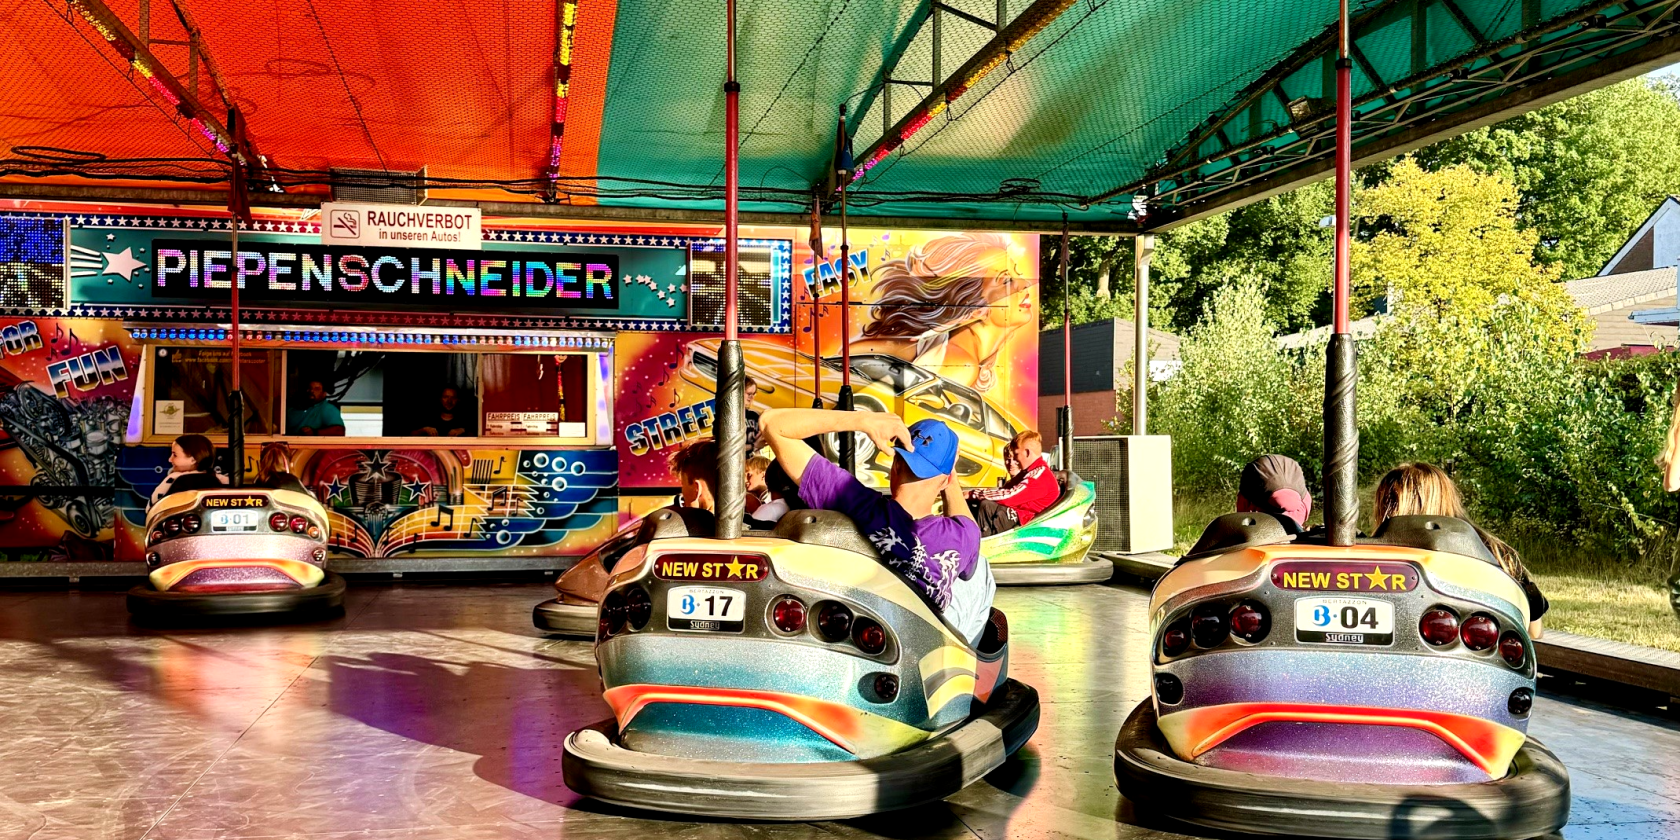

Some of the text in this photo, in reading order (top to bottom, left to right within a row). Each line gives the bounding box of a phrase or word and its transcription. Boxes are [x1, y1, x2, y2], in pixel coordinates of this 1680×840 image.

[367, 210, 473, 230] RAUCHVERBOT
[378, 228, 462, 242] in unseren Autos!
[157, 248, 614, 300] PIEPENSCHNEIDER
[802, 248, 872, 301] EASY
[0, 320, 43, 356] OR
[46, 345, 128, 399] FUN
[487, 413, 521, 421] FAHRPREIS
[523, 413, 556, 421] FAHRPREIS
[206, 498, 229, 507] NEW
[662, 561, 699, 577] NEW
[1283, 571, 1331, 589] NEW
[690, 620, 720, 630] Sydney
[1326, 633, 1364, 643] Sydney
